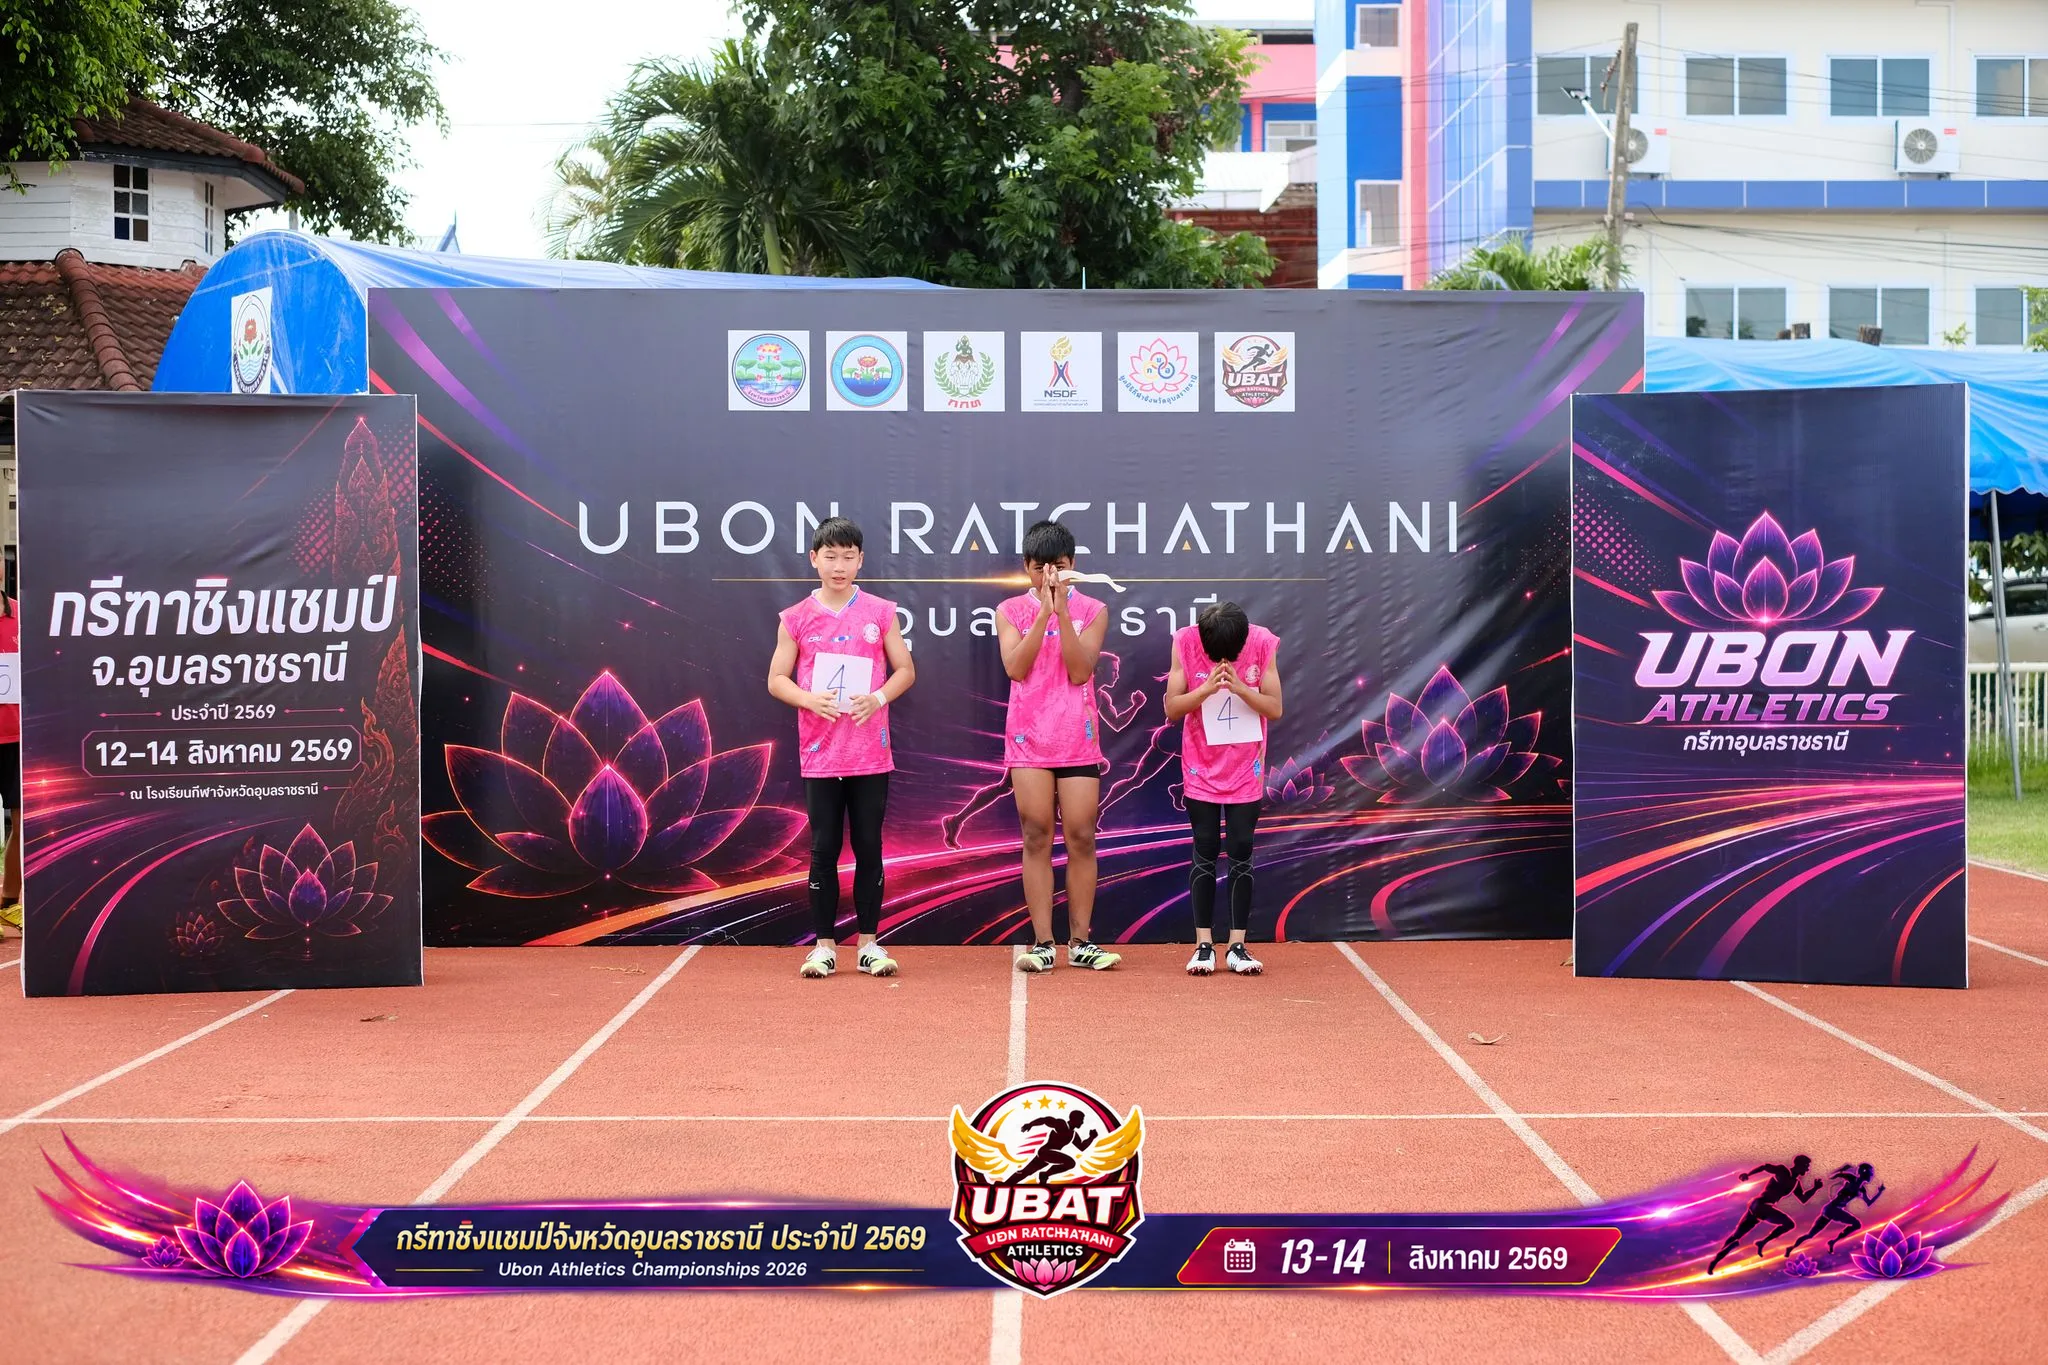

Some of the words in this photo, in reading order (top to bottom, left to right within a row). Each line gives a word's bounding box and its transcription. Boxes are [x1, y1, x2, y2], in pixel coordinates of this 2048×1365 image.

[1044, 390, 1078, 398] NSDF
[1228, 372, 1283, 387] UBAT
[49, 575, 398, 637] กรีฑาชิงแชมป์
[92, 641, 348, 698] จ.อุบลราชธานี
[1634, 630, 1916, 688] UBON
[826, 663, 846, 703] 4
[171, 703, 229, 721] ประจำปี
[234, 704, 276, 720] 2569
[1217, 695, 1239, 731] 4
[1634, 693, 1902, 725] ATHLETICS
[96, 740, 178, 767] 12-14
[188, 739, 281, 765] สิงหาคม
[290, 738, 353, 763] 2569
[1683, 730, 1850, 757] กรีฑาอุบลราชธานี
[130, 789, 142, 800] ณ
[146, 781, 319, 800] โรงเรียนกีฬาจังหวัดอุบลราชธานี
